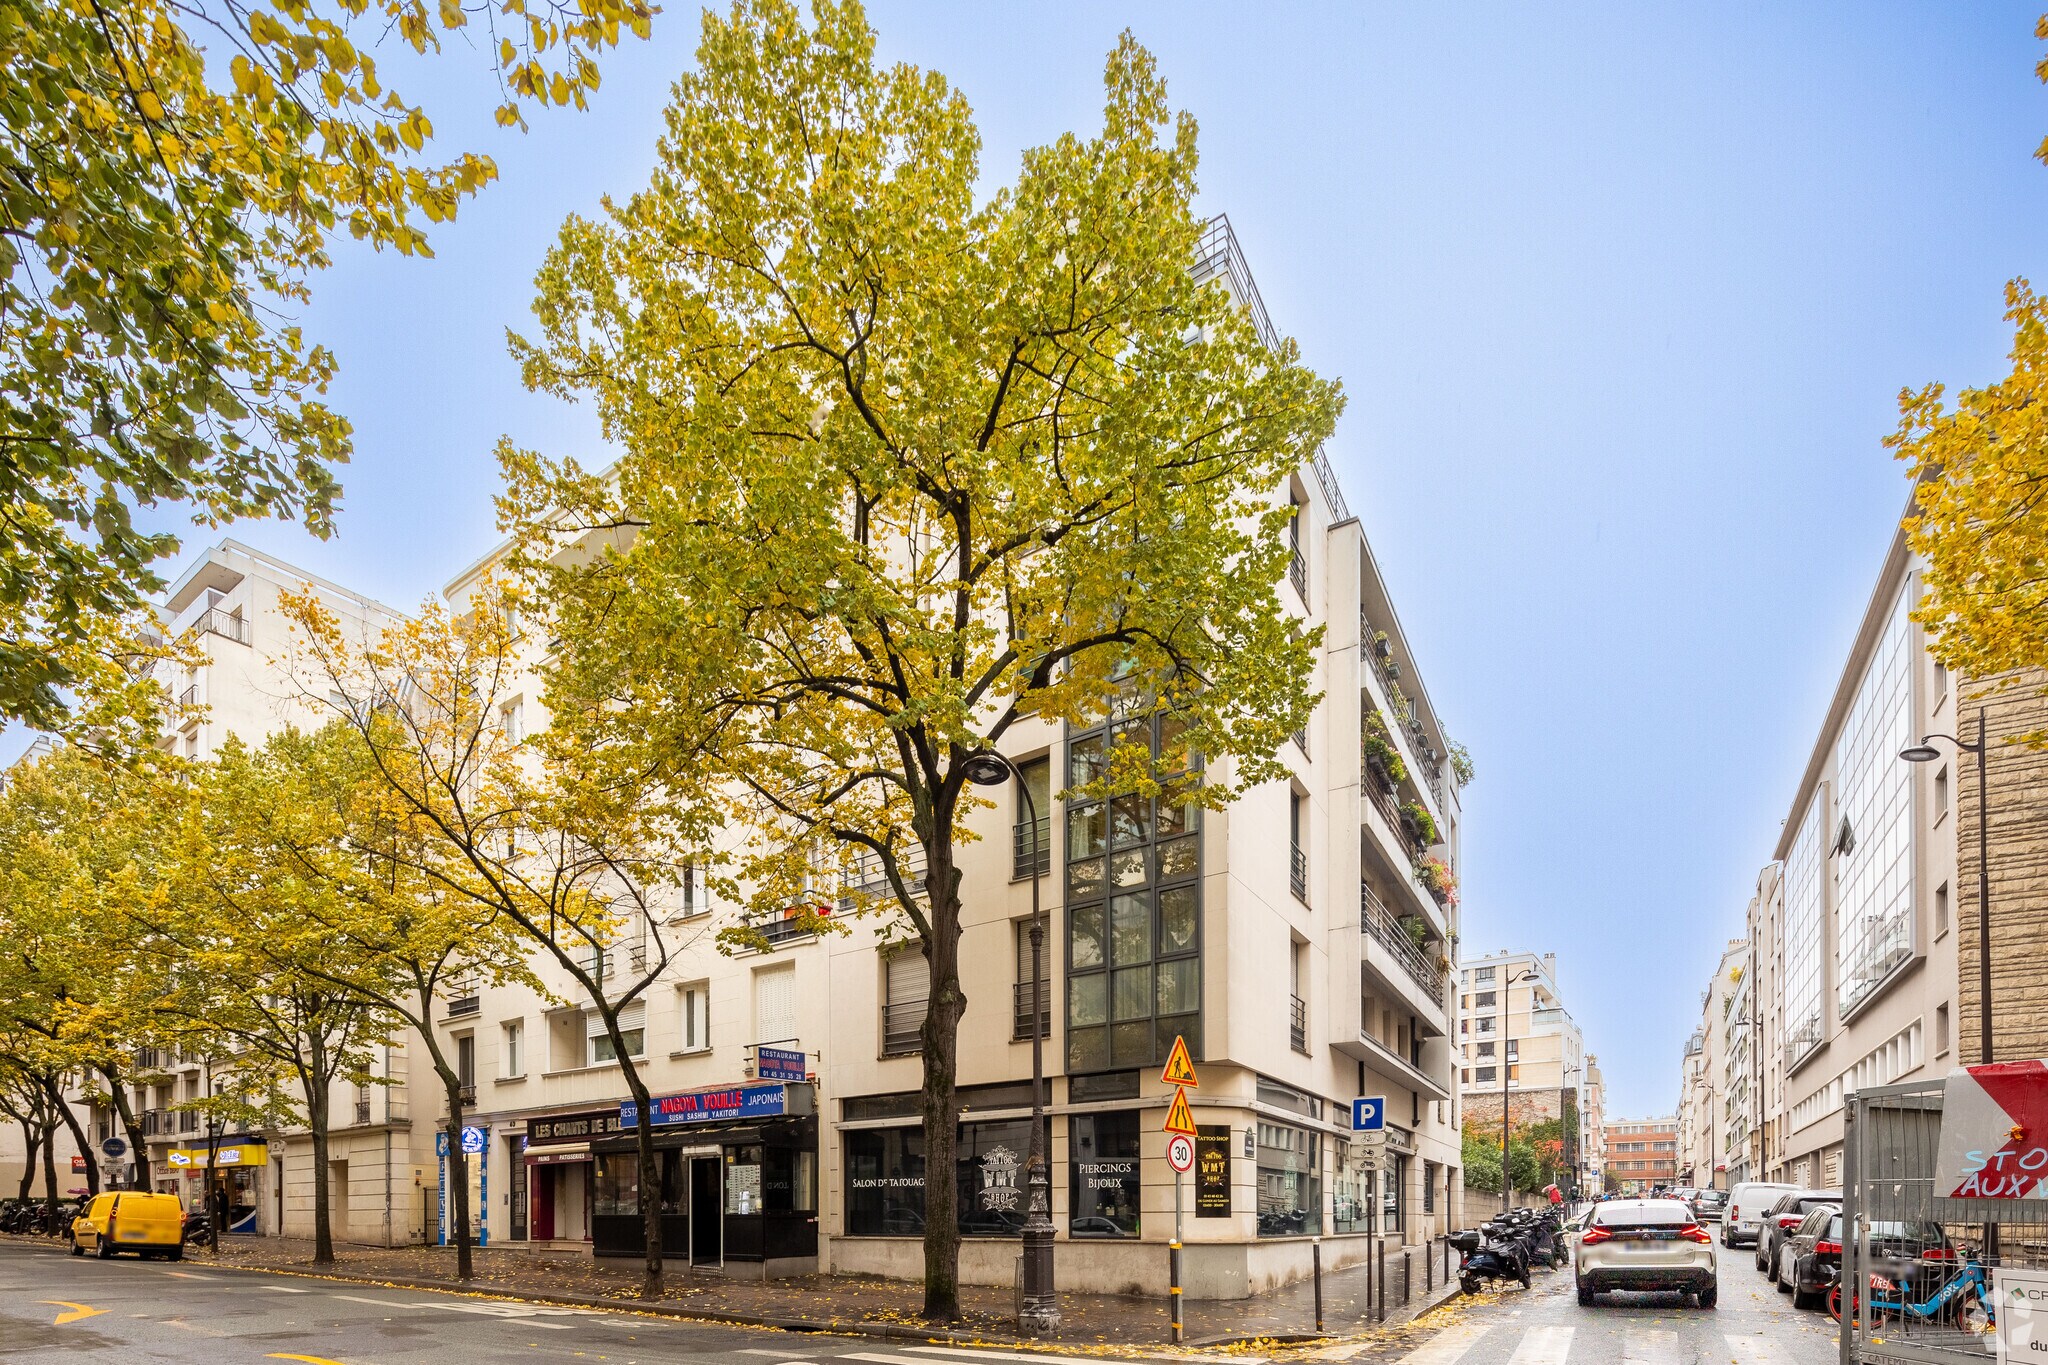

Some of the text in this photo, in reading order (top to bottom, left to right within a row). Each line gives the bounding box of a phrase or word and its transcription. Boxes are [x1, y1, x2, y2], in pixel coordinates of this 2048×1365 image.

[761, 1050, 800, 1060] RESTAURANT
[661, 1091, 742, 1114] NAGOYA VOUILLE
[748, 1092, 784, 1106] JAPONAIS
[621, 1104, 658, 1118] RESTANT
[687, 1112, 708, 1120] SASHIMI
[712, 1109, 738, 1118] YAKITORI
[1360, 1104, 1375, 1125] P
[535, 1124, 551, 1138] LES
[554, 1120, 588, 1136] CHANTS
[591, 1119, 604, 1133] DE
[1175, 1146, 1187, 1161] 30
[1079, 1163, 1131, 1173] PIERCINGS
[1202, 1162, 1225, 1173] WMT
[853, 1179, 876, 1187] SALON
[983, 1169, 1017, 1188] WMT
[1088, 1178, 1122, 1189] BIJOUX
[1960, 1172, 2029, 1197] AUX
[2030, 1340, 2048, 1352] du
